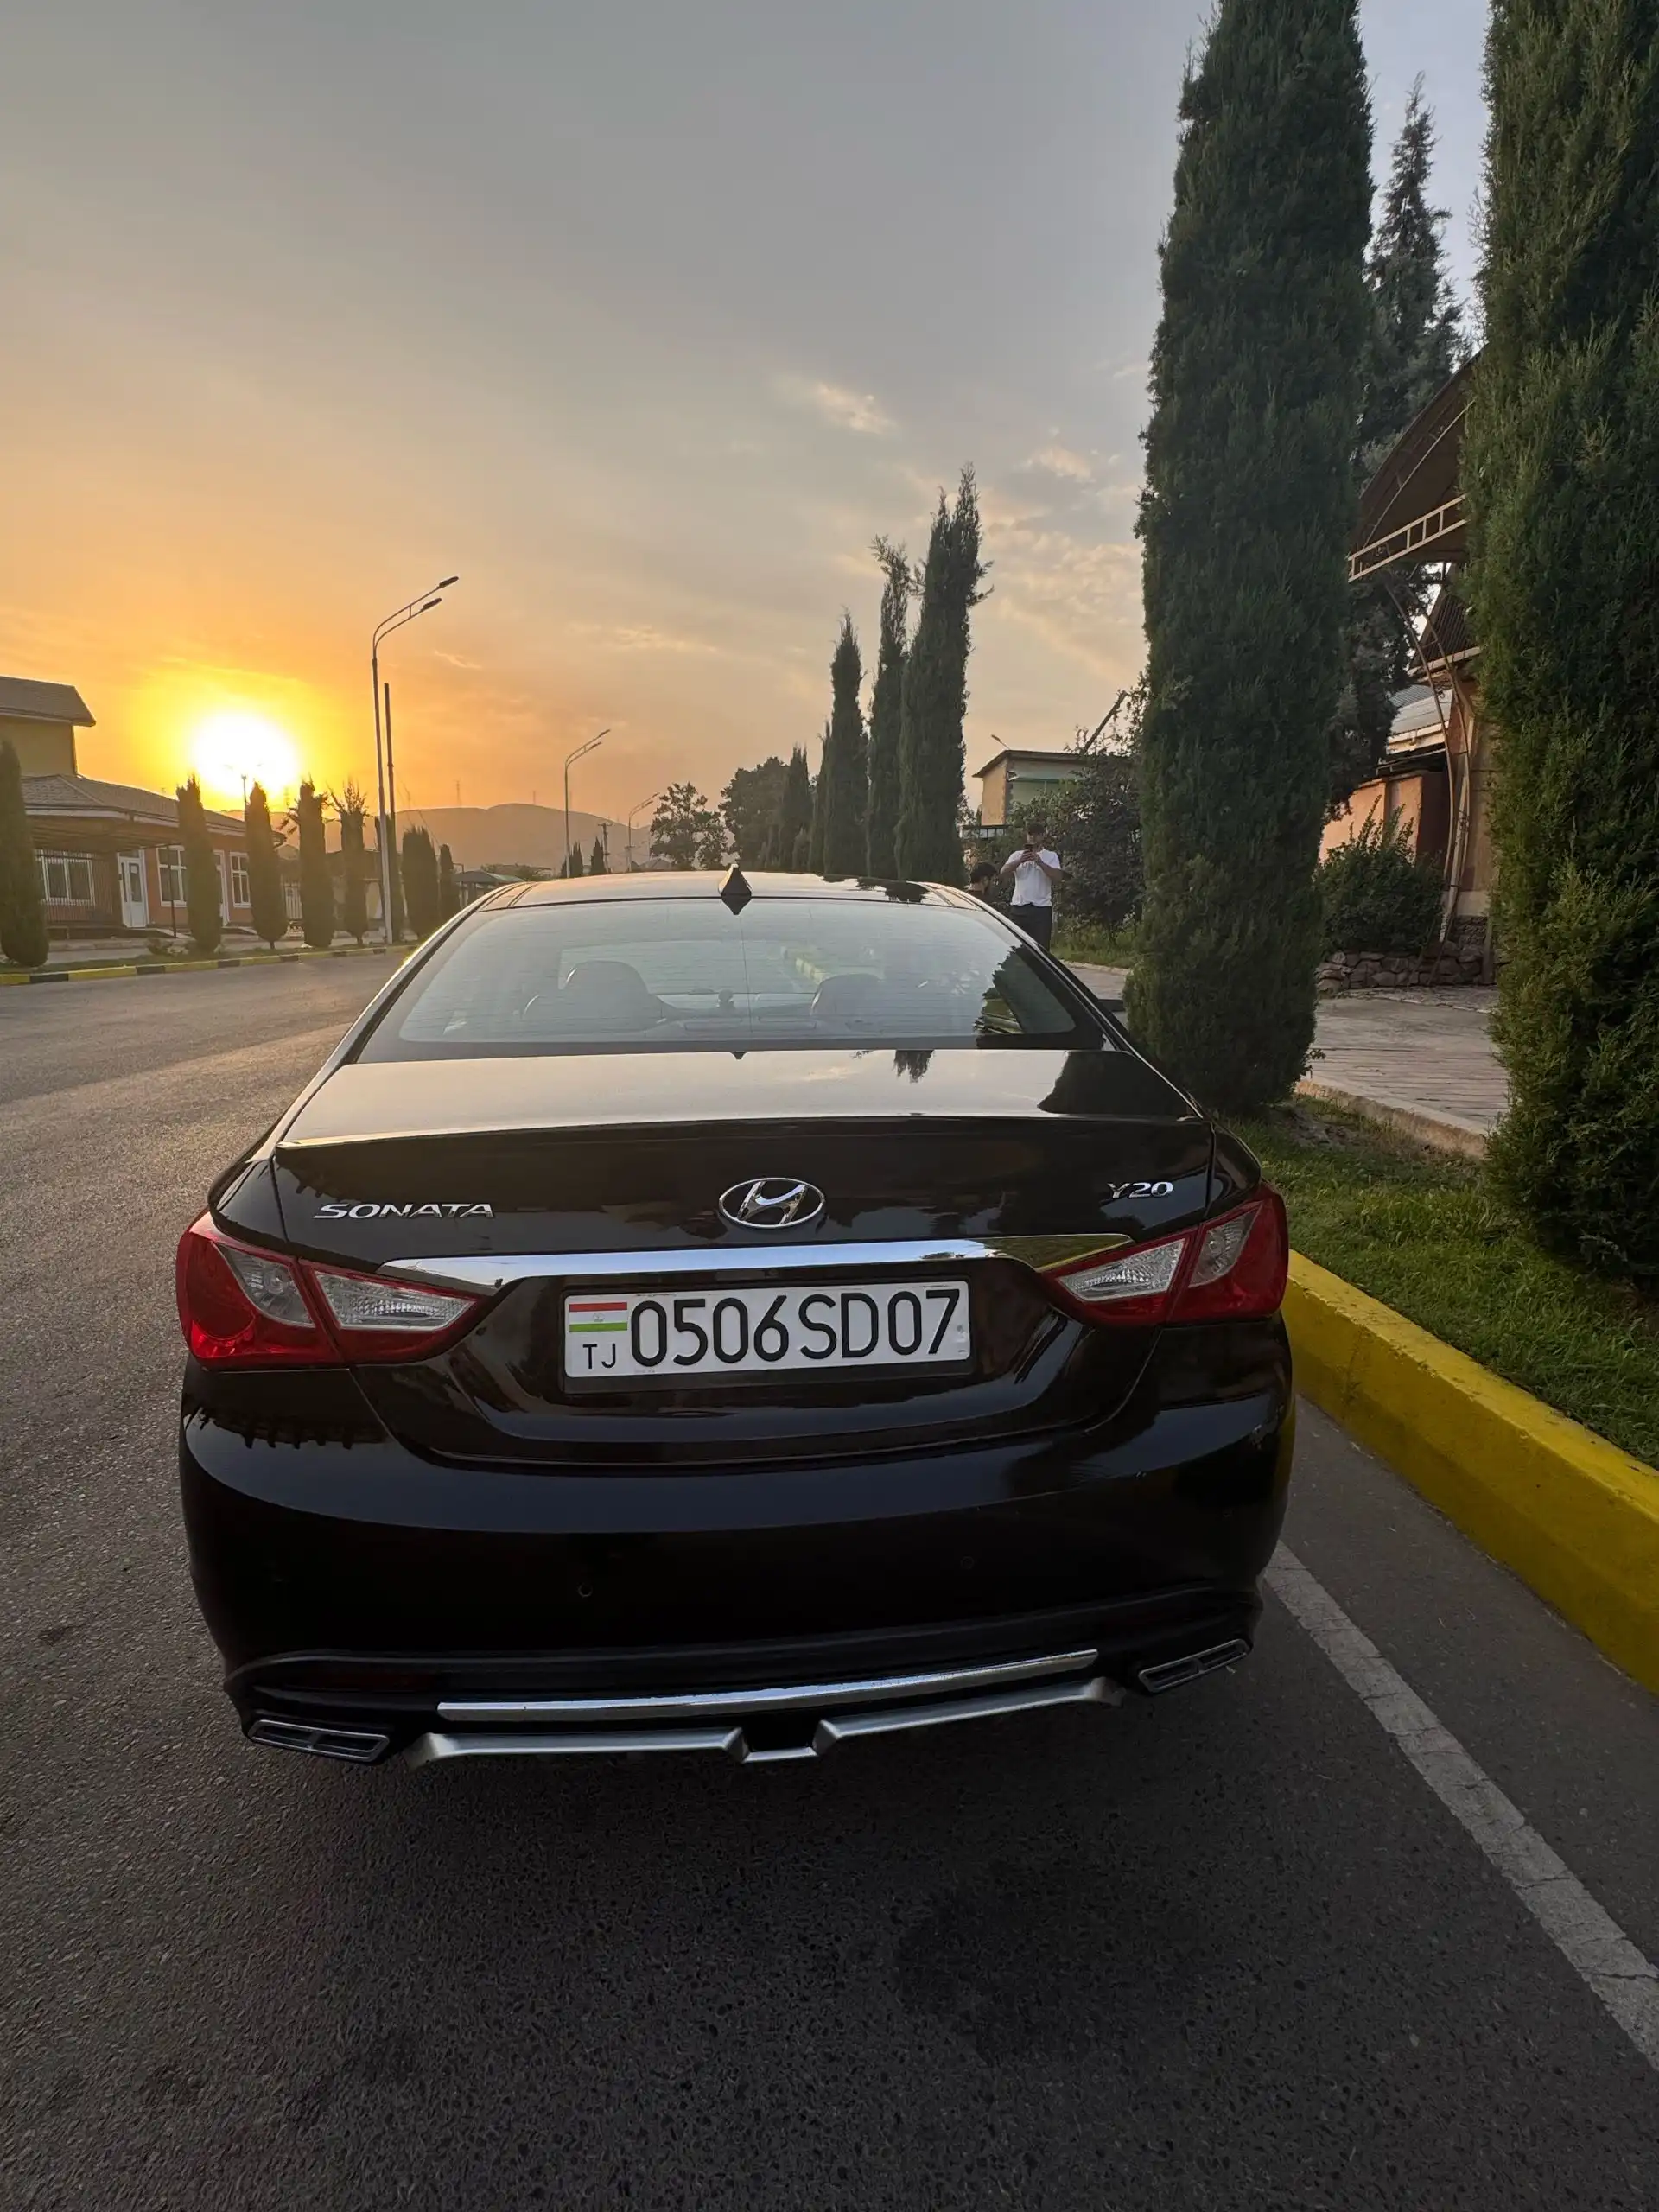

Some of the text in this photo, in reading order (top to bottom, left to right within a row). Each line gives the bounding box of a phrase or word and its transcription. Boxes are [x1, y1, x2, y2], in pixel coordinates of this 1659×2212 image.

[1107, 1181, 1174, 1199] Y20
[313, 1203, 495, 1219] SONATA
[631, 1288, 960, 1367] 0506SD07
[582, 1343, 616, 1370] TJ
